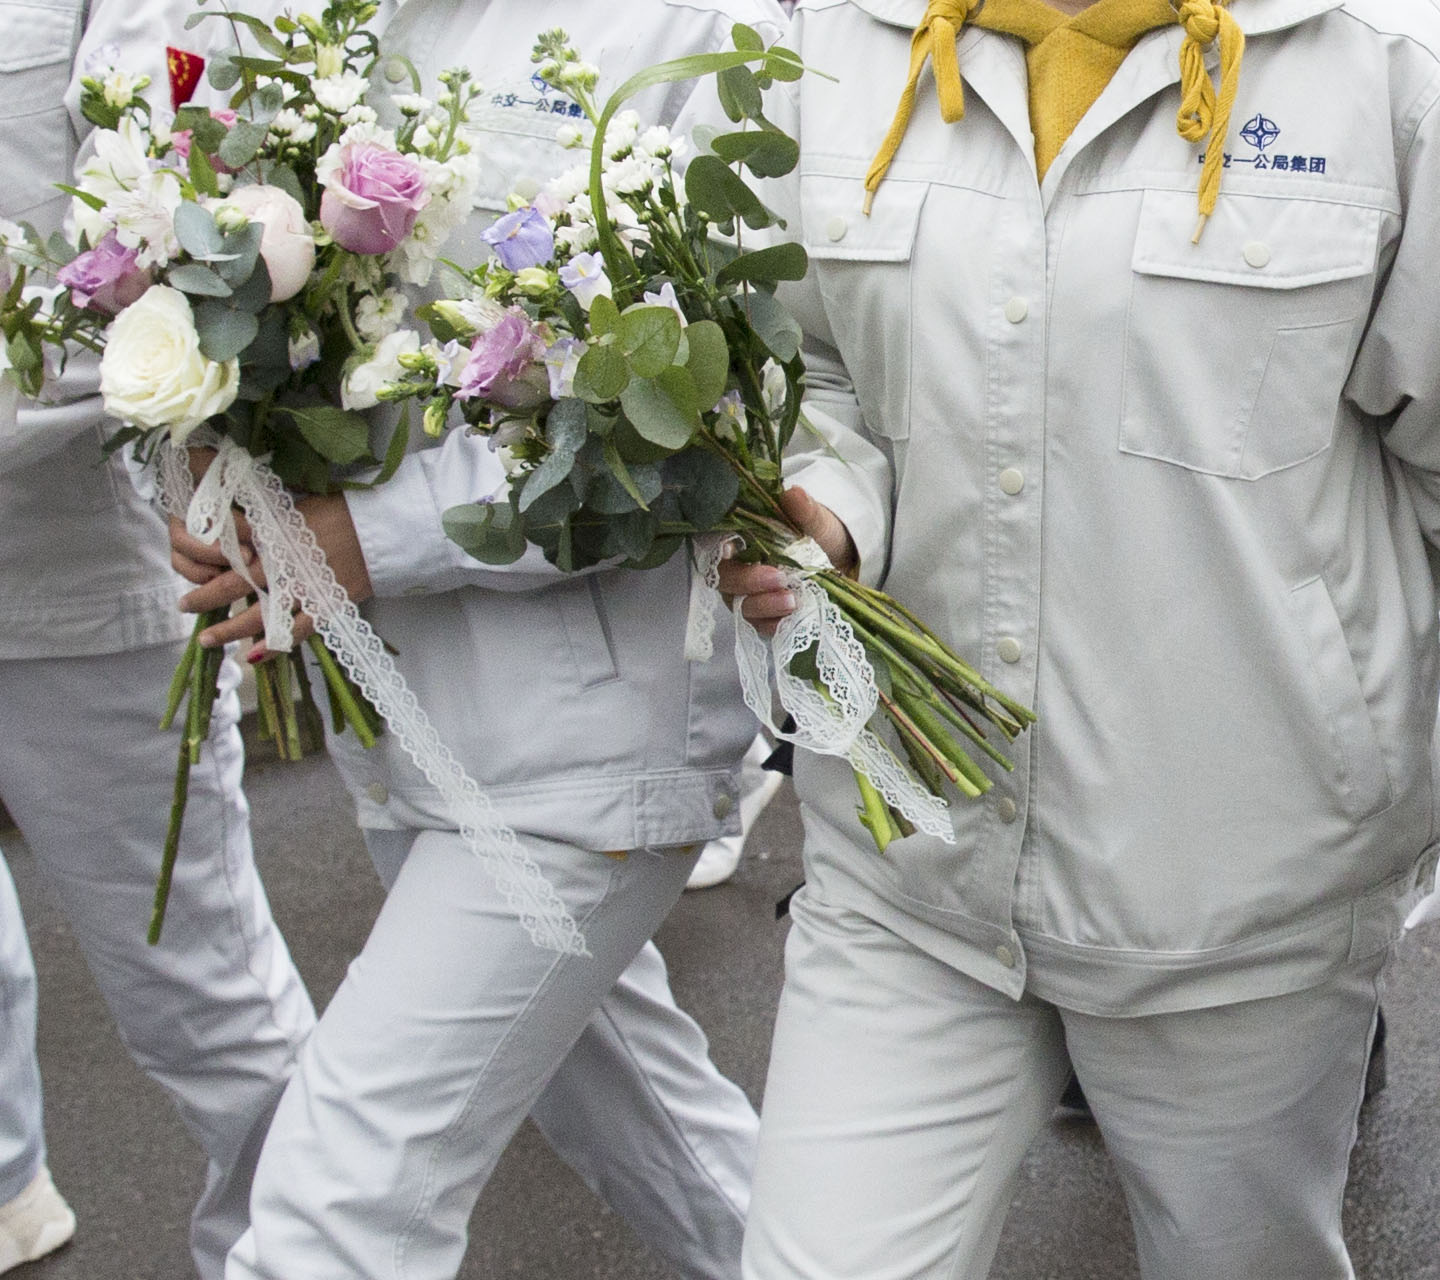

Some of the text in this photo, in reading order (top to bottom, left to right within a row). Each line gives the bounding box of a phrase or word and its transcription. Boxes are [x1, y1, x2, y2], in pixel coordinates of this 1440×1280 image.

[491, 93, 588, 119] 中交一公局集
